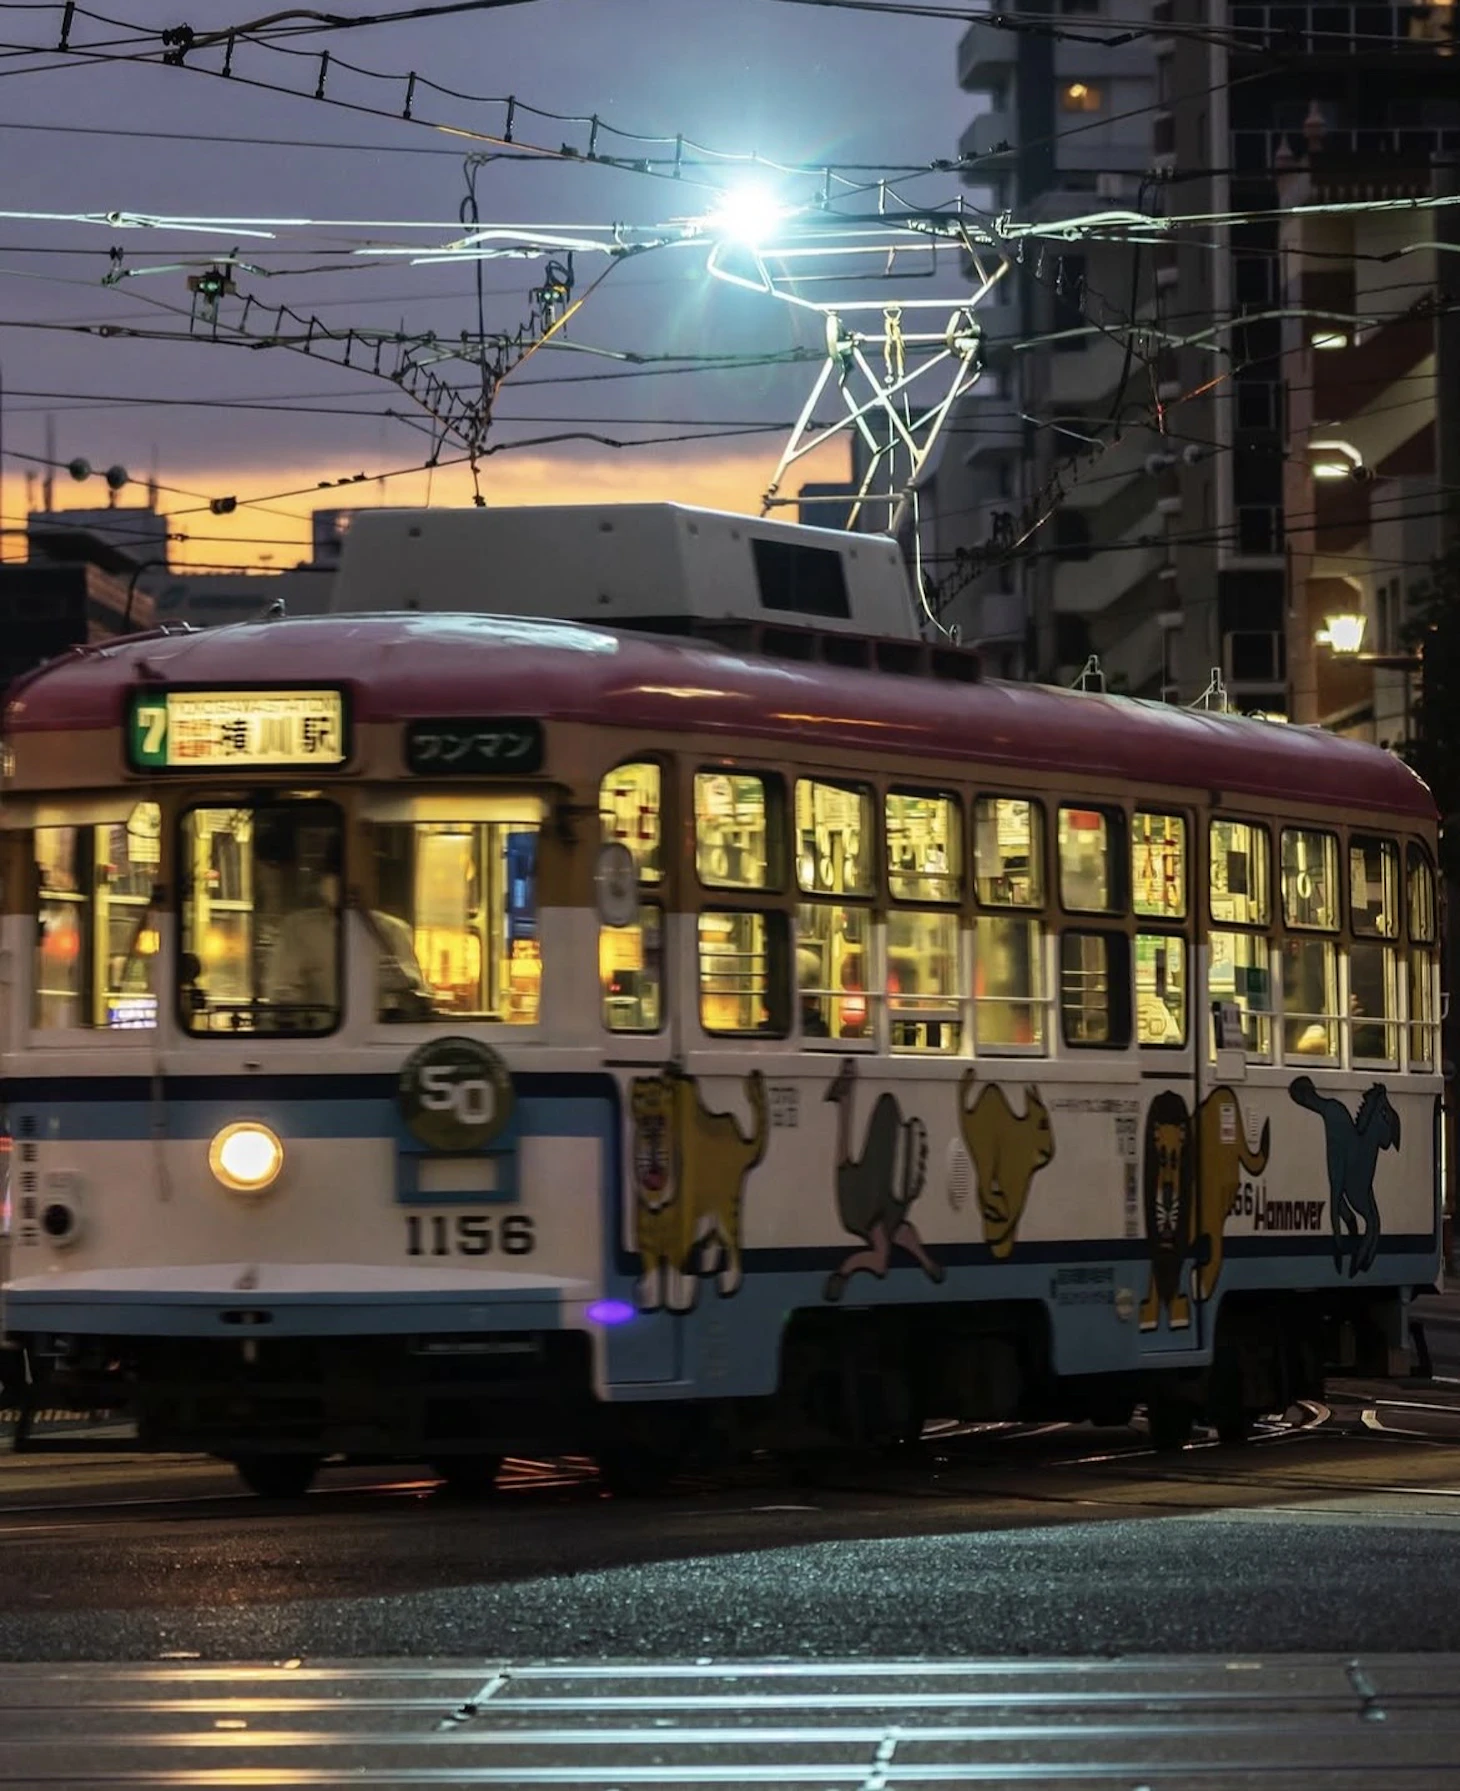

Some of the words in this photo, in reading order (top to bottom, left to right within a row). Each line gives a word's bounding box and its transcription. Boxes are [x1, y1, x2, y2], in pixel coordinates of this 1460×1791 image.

[413, 732, 534, 760] ワンマン
[420, 1065, 494, 1124] 50
[1254, 1184, 1325, 1230] Hannover
[405, 1215, 536, 1255] 1156
